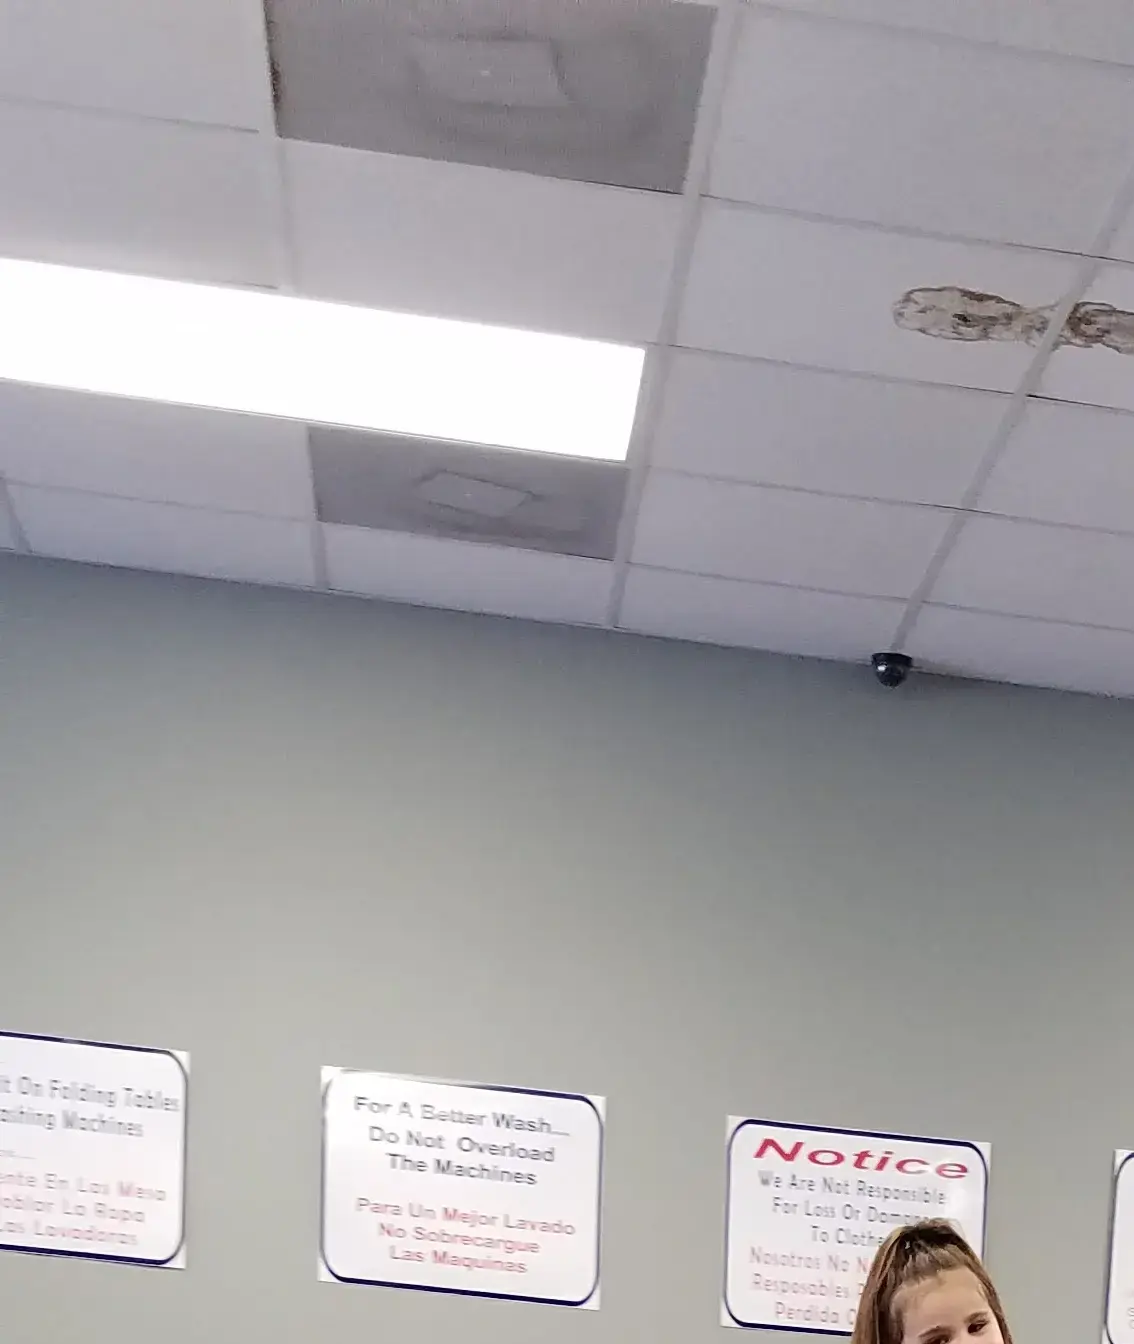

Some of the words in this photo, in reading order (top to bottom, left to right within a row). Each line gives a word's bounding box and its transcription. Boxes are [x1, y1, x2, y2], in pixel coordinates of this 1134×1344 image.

[49, 1079, 117, 1107] Folding
[123, 1087, 180, 1111] Tables
[62, 1110, 143, 1137] Machines
[354, 1096, 393, 1114] For
[398, 1101, 413, 1117] A
[421, 1104, 486, 1126] Better
[369, 1126, 400, 1143] Do
[406, 1130, 445, 1149] Not
[457, 1137, 555, 1162] Overload
[754, 1138, 968, 1179] Notice
[386, 1153, 427, 1172] The
[434, 1159, 537, 1185] Machines
[758, 1170, 781, 1188] We
[789, 1174, 815, 1191] Are
[822, 1177, 849, 1195] Not
[857, 1180, 945, 1204] Responsible
[356, 1197, 403, 1216] Para
[408, 1203, 436, 1220] Un
[442, 1207, 498, 1228] Mejor
[505, 1214, 576, 1235] Lavado
[772, 1197, 798, 1215] For
[804, 1200, 836, 1219] Loss
[842, 1205, 861, 1221] Or
[378, 1223, 406, 1238] No
[412, 1227, 540, 1254] Sobrecargue
[811, 1226, 828, 1243] To
[836, 1228, 883, 1246] Clothe
[389, 1246, 424, 1261] Las
[432, 1250, 527, 1273] Maquinas
[750, 1247, 820, 1269] Nosotros
[827, 1255, 850, 1272] No
